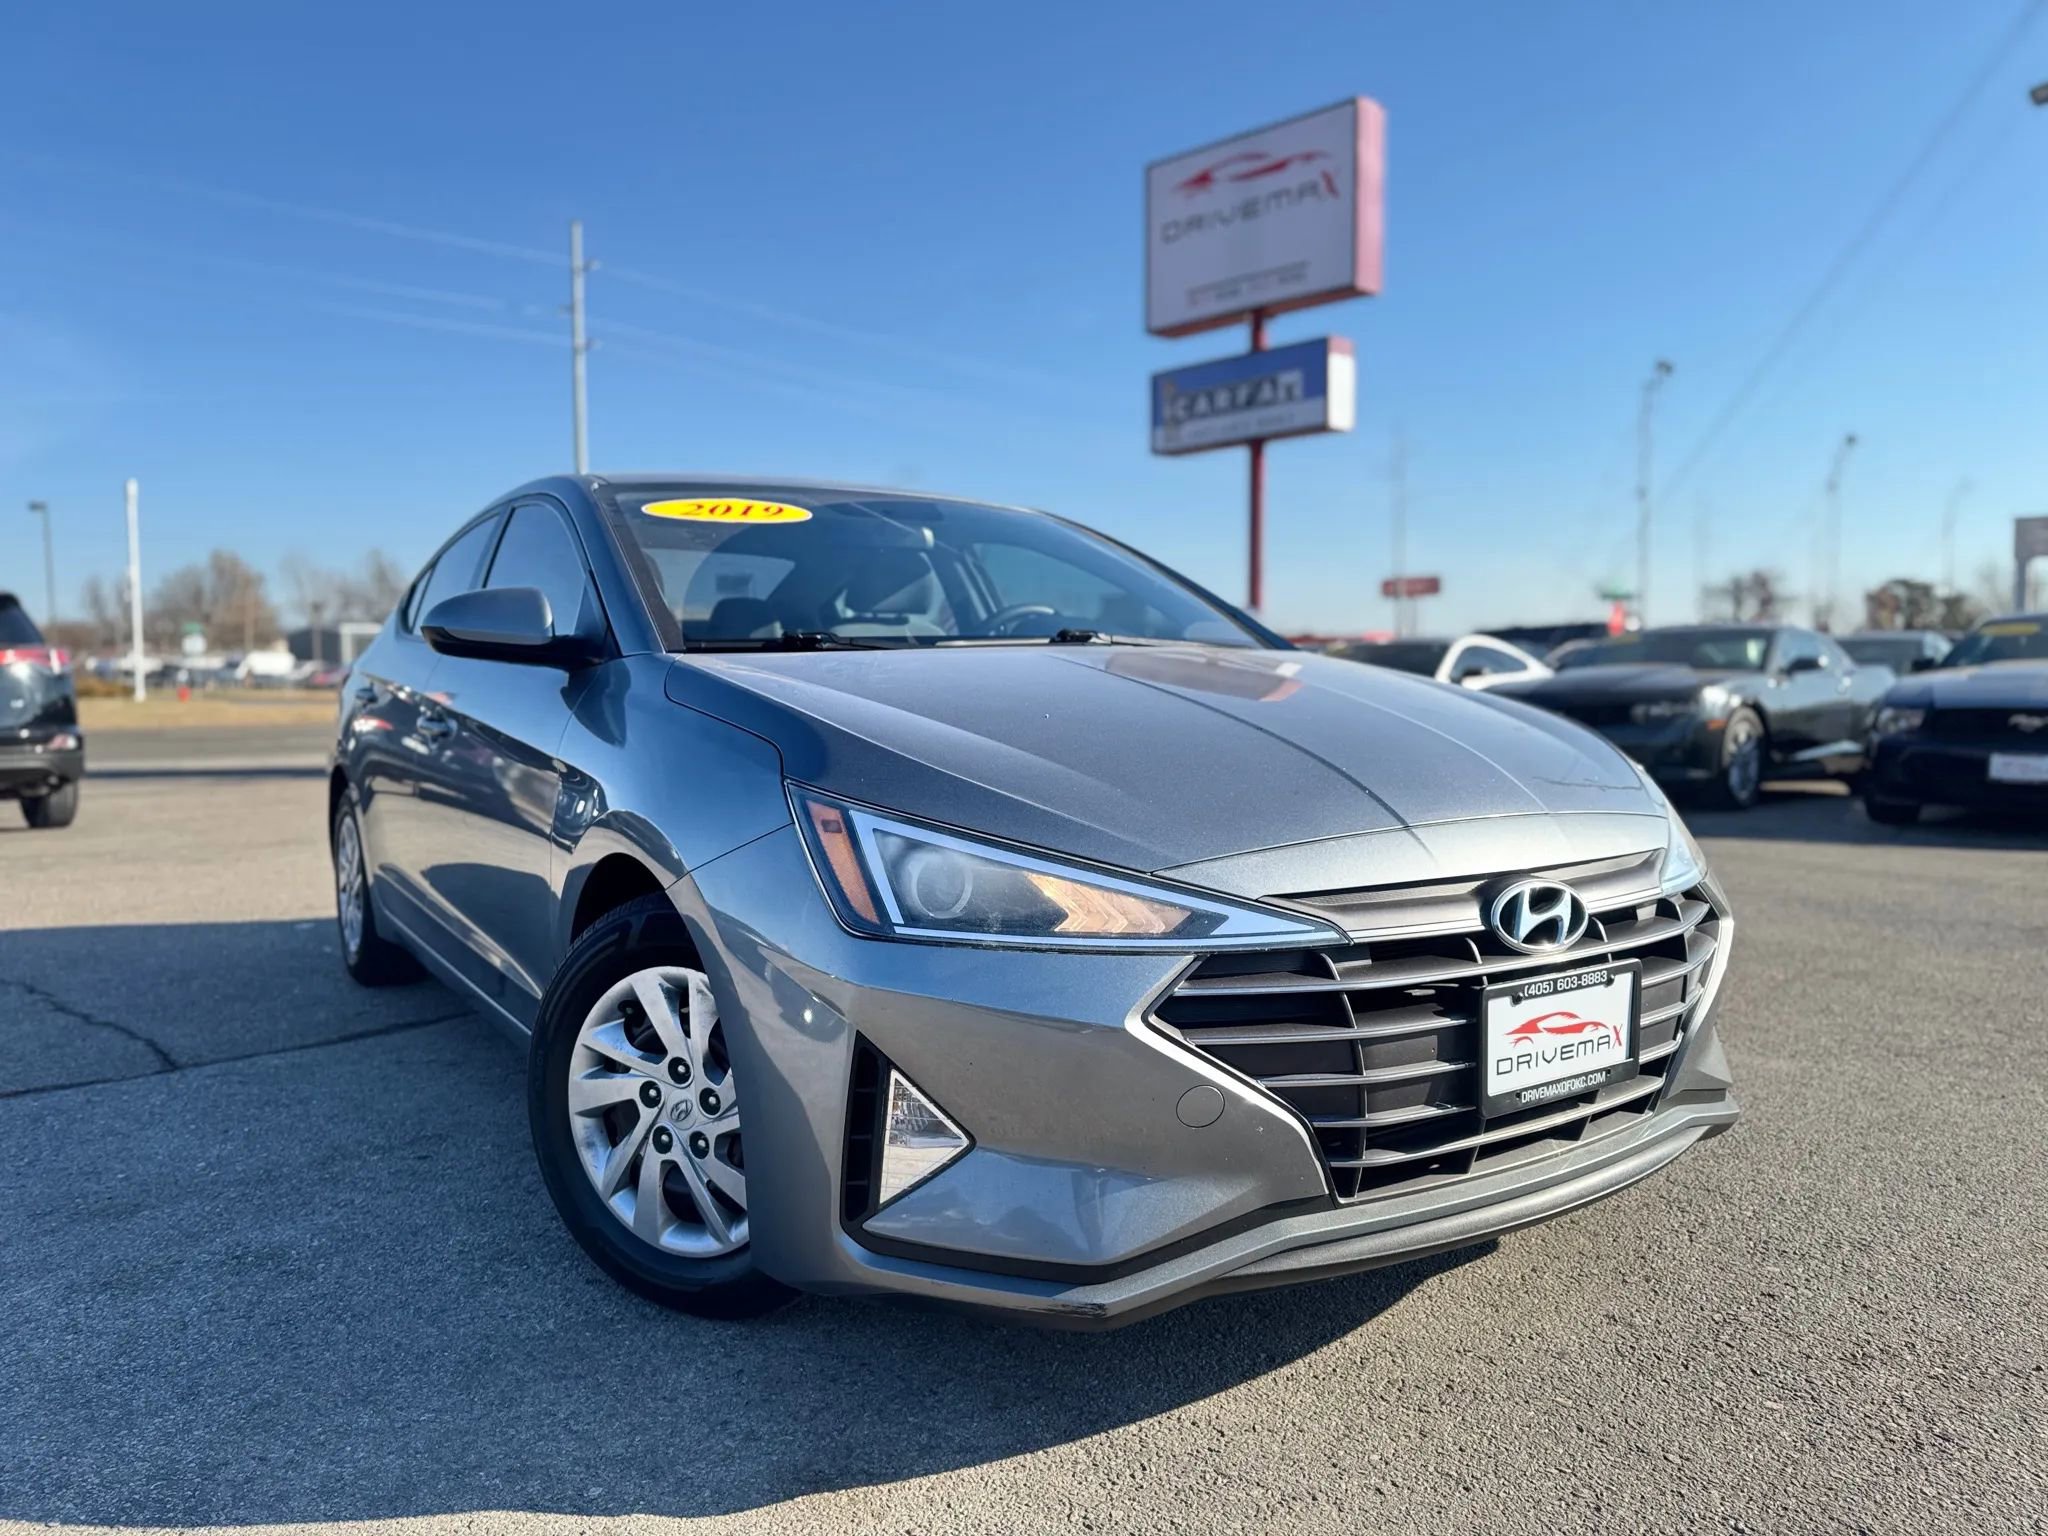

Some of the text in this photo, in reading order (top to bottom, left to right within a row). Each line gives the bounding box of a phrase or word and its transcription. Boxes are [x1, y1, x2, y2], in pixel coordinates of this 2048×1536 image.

[1160, 169, 1340, 244] DRIVEMAX
[680, 503, 784, 517] 2019
[1524, 970, 1608, 998] (405) 603-8883
[1496, 1024, 1623, 1076] DRIVEMAX
[1521, 1071, 1606, 1103] DRIVEMAXOFOKC.COM
